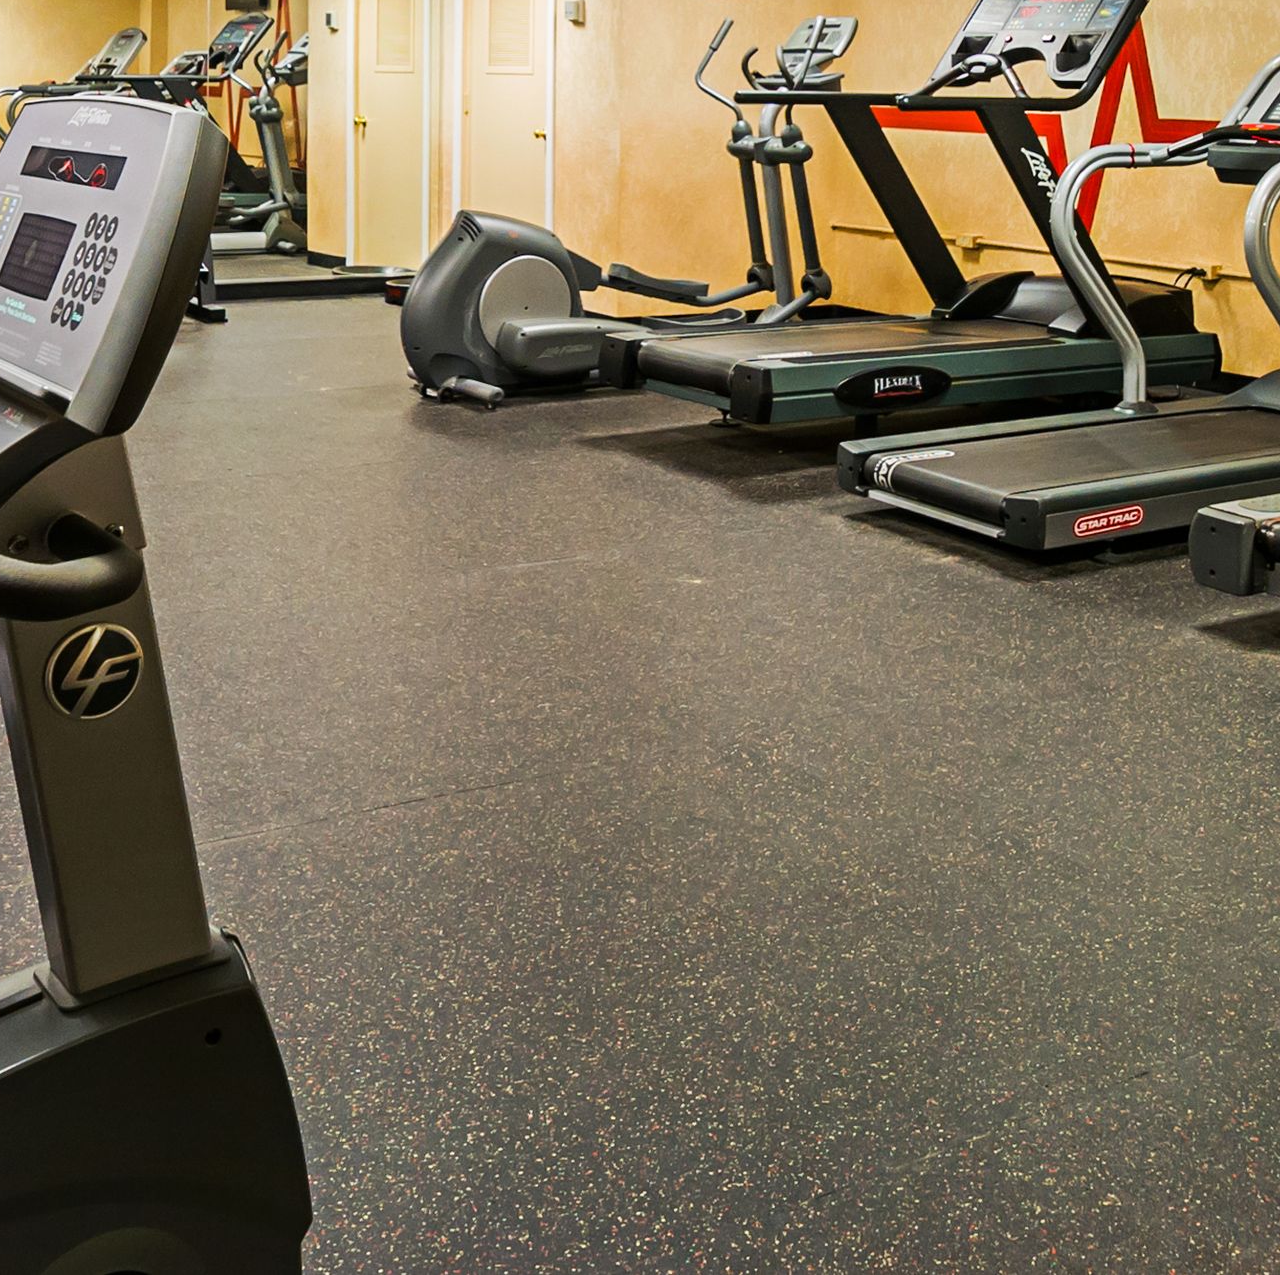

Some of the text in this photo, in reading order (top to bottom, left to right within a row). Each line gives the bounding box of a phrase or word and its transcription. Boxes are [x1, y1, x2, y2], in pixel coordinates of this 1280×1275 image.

[97, 220, 106, 234] 2
[107, 222, 115, 237] 3
[76, 247, 85, 262] 4
[86, 251, 95, 265] 5
[1079, 511, 1138, 532] STAR TRAC
